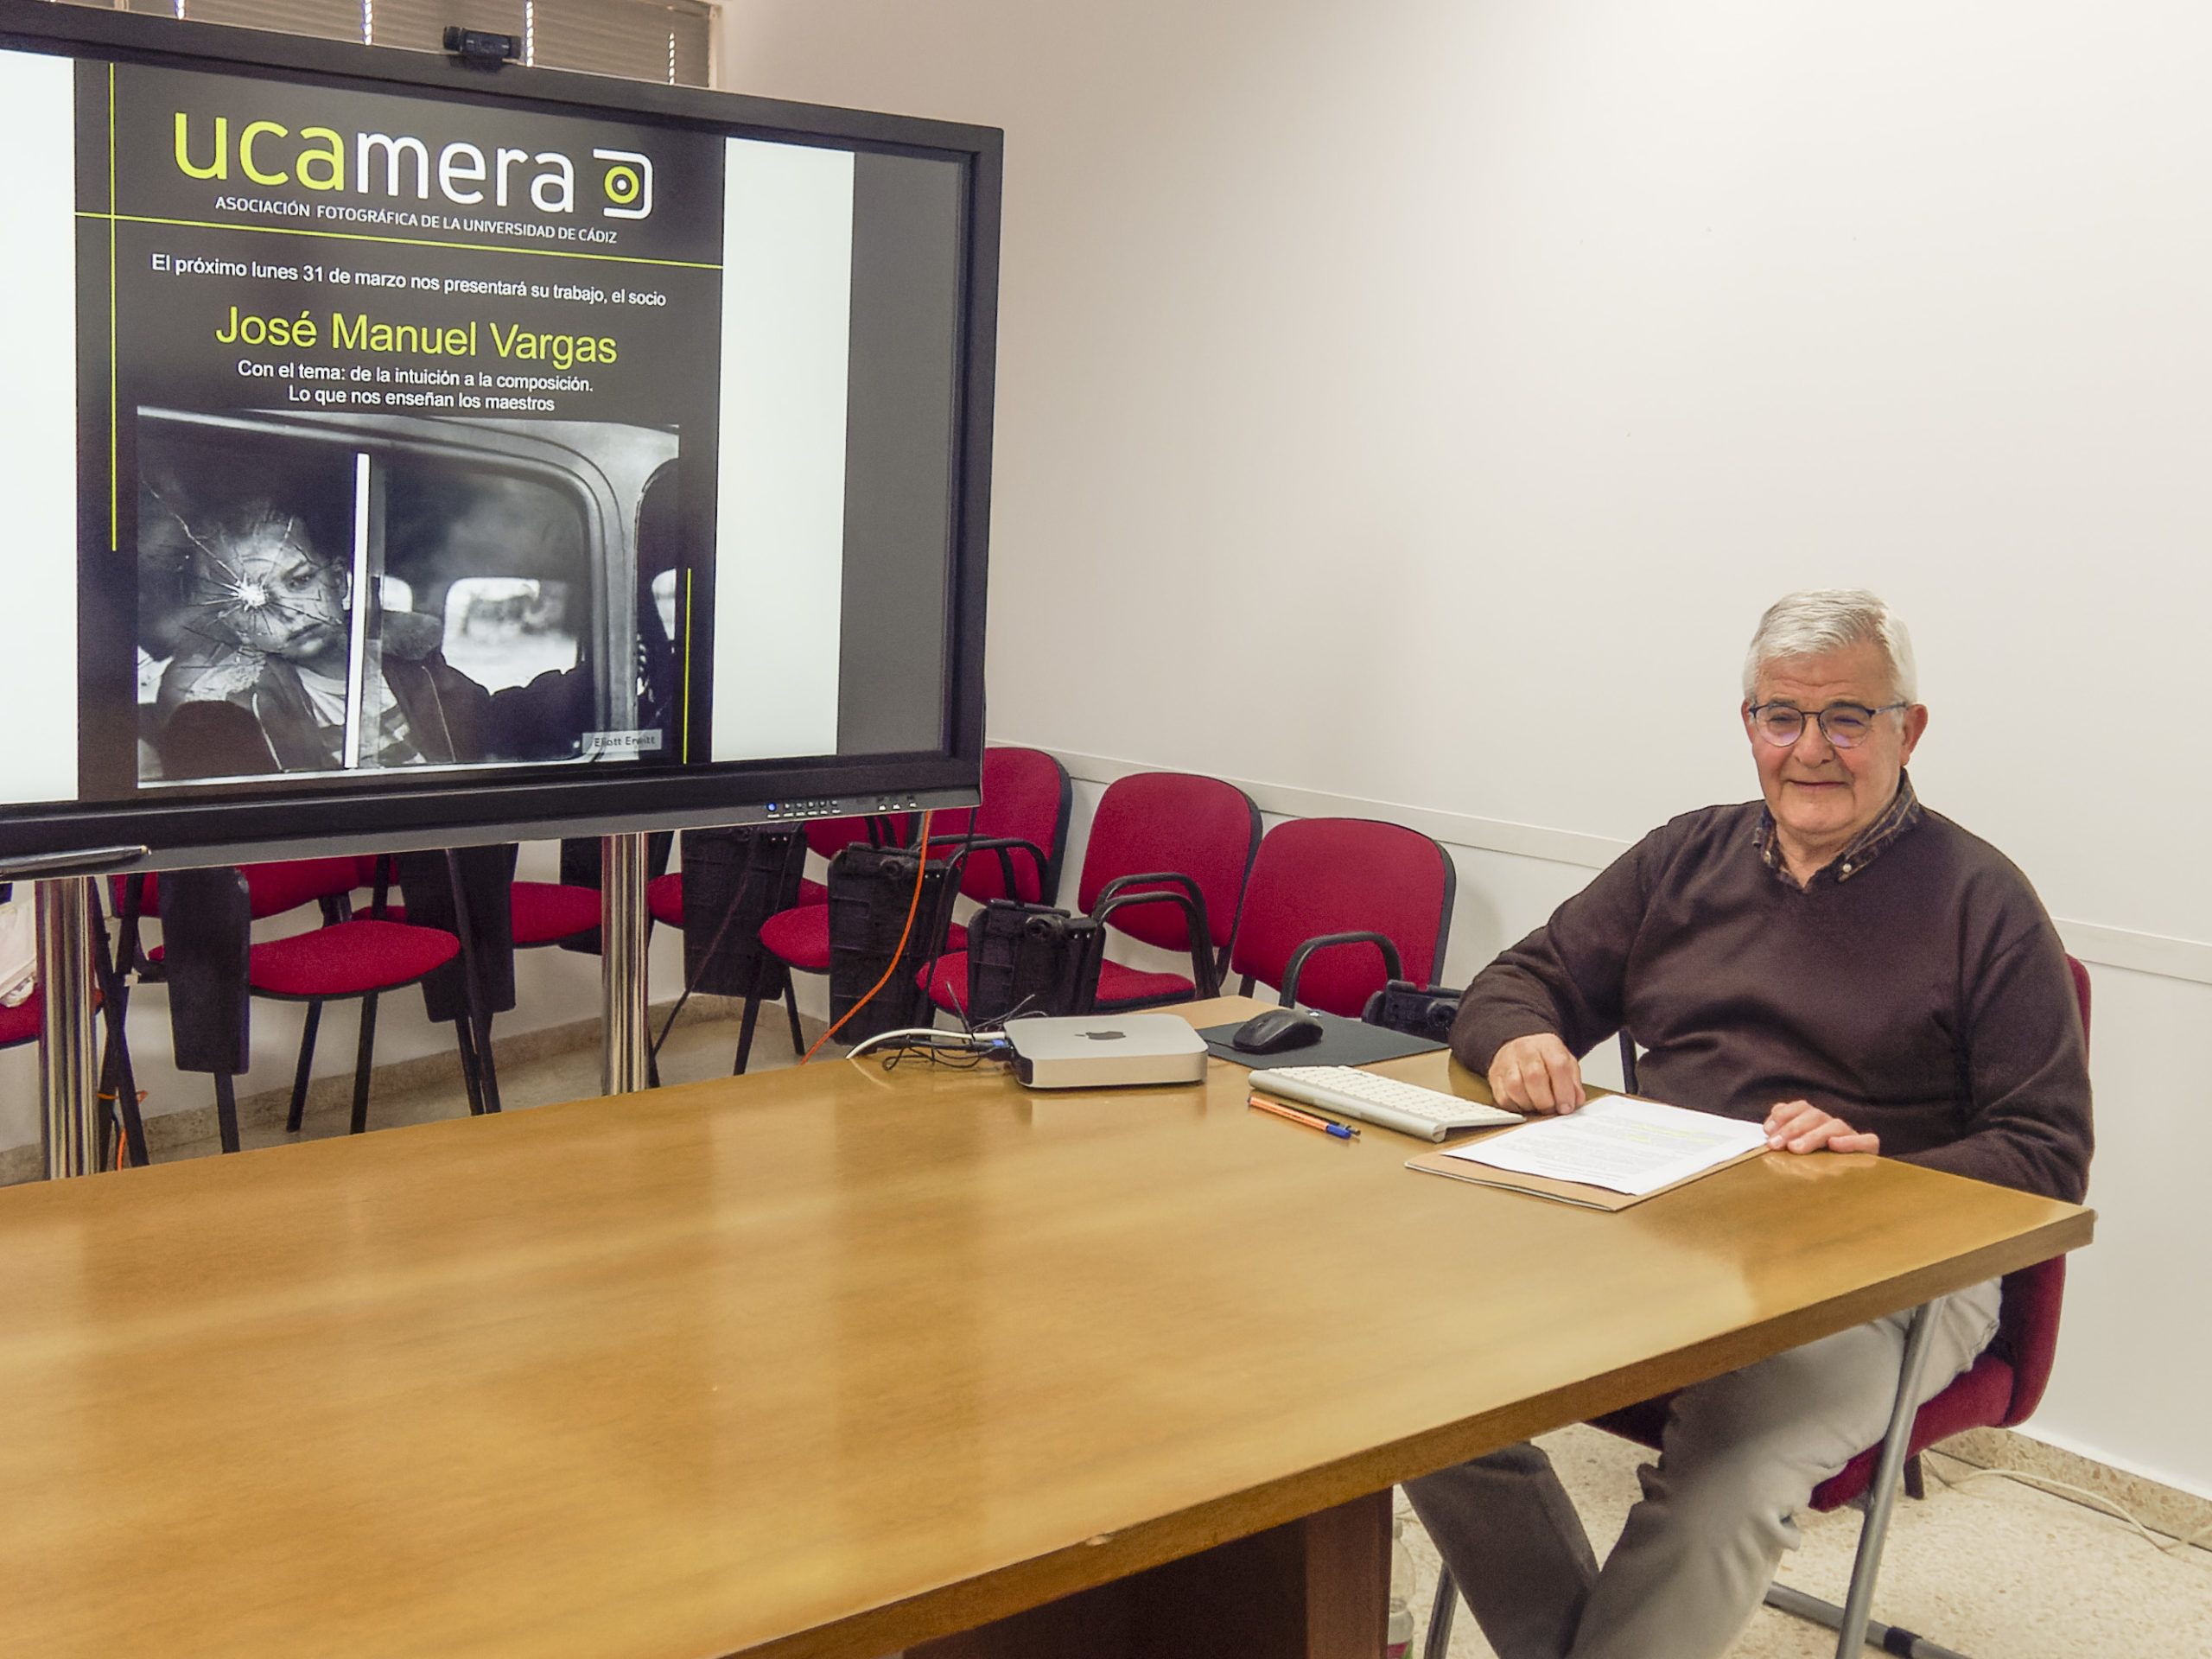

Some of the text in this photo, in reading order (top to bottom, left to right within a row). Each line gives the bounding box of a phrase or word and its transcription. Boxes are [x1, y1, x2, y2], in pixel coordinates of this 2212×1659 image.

[175, 111, 575, 213] ucamera
[215, 196, 618, 244] ASOCIACIÓN FOTOGRÁFICA DE LA UNIVERSIDAD DE CÁDIZ
[151, 252, 667, 307] El próximo lunes 31 de marzo nos presentará su trabajo, el socio
[215, 306, 618, 371] José Manuel Vargas
[238, 359, 594, 393] Con el tema: de la intuición a la composición.
[289, 385, 556, 412] Lo que nos enseñan los maestros
